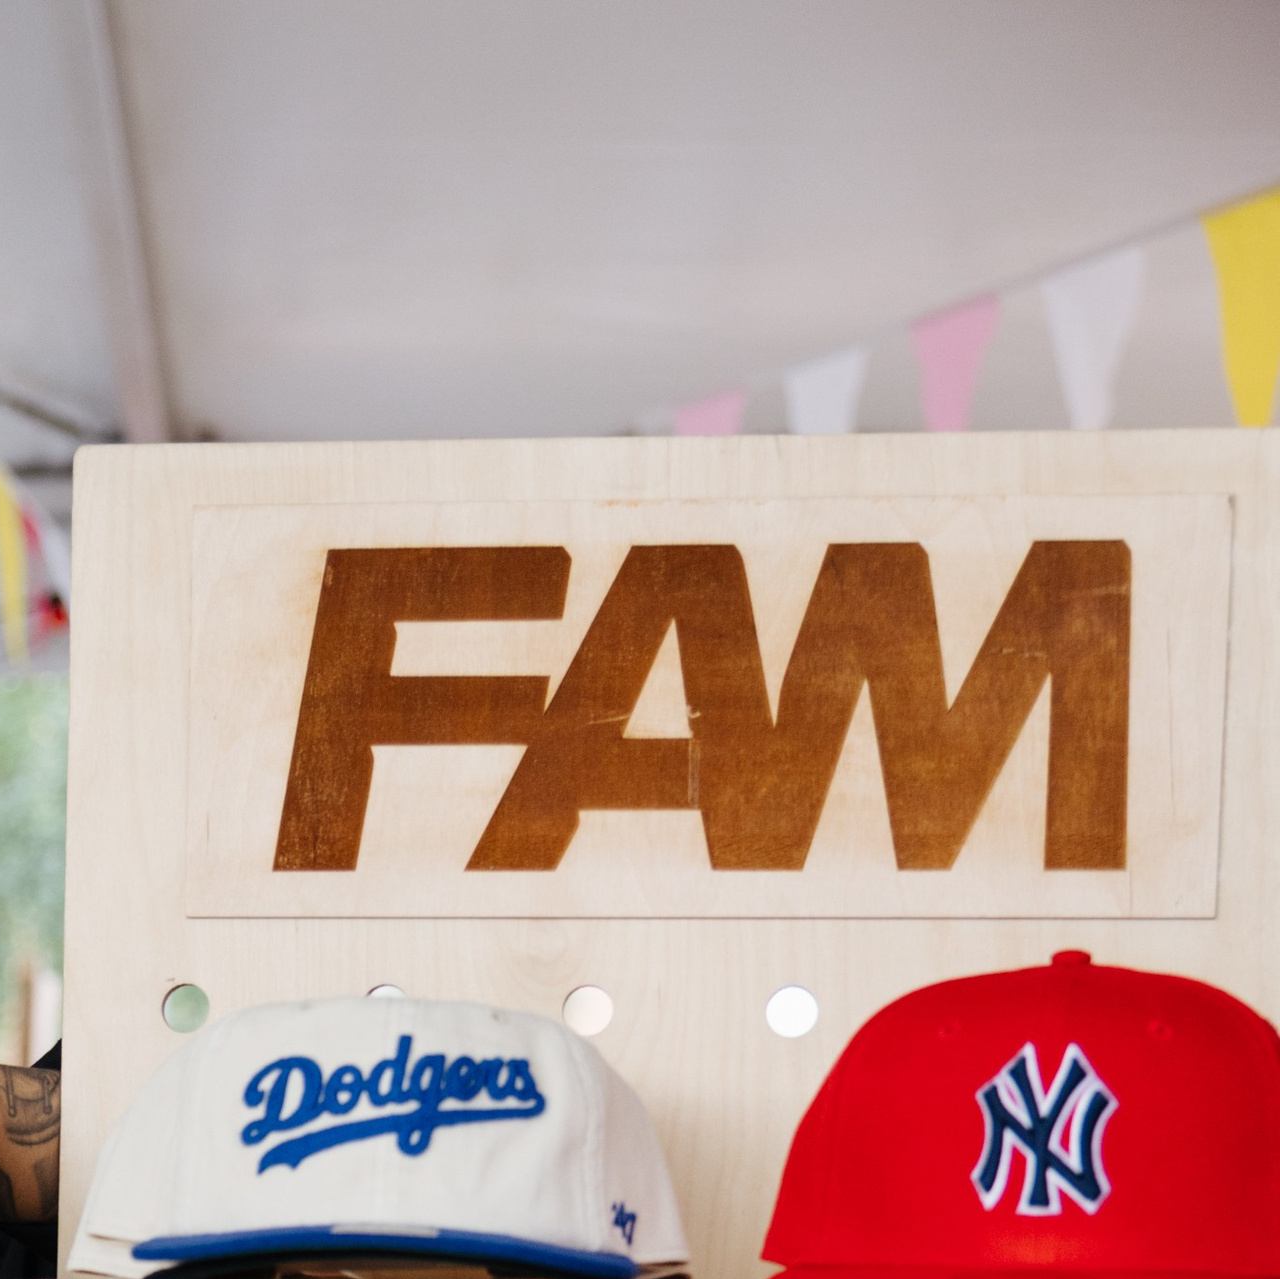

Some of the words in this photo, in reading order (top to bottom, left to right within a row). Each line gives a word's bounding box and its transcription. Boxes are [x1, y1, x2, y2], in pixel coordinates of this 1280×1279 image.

[271, 539, 1133, 872] FAM
[240, 1032, 547, 1173] Dodgers
[970, 1040, 1119, 1218] NY
